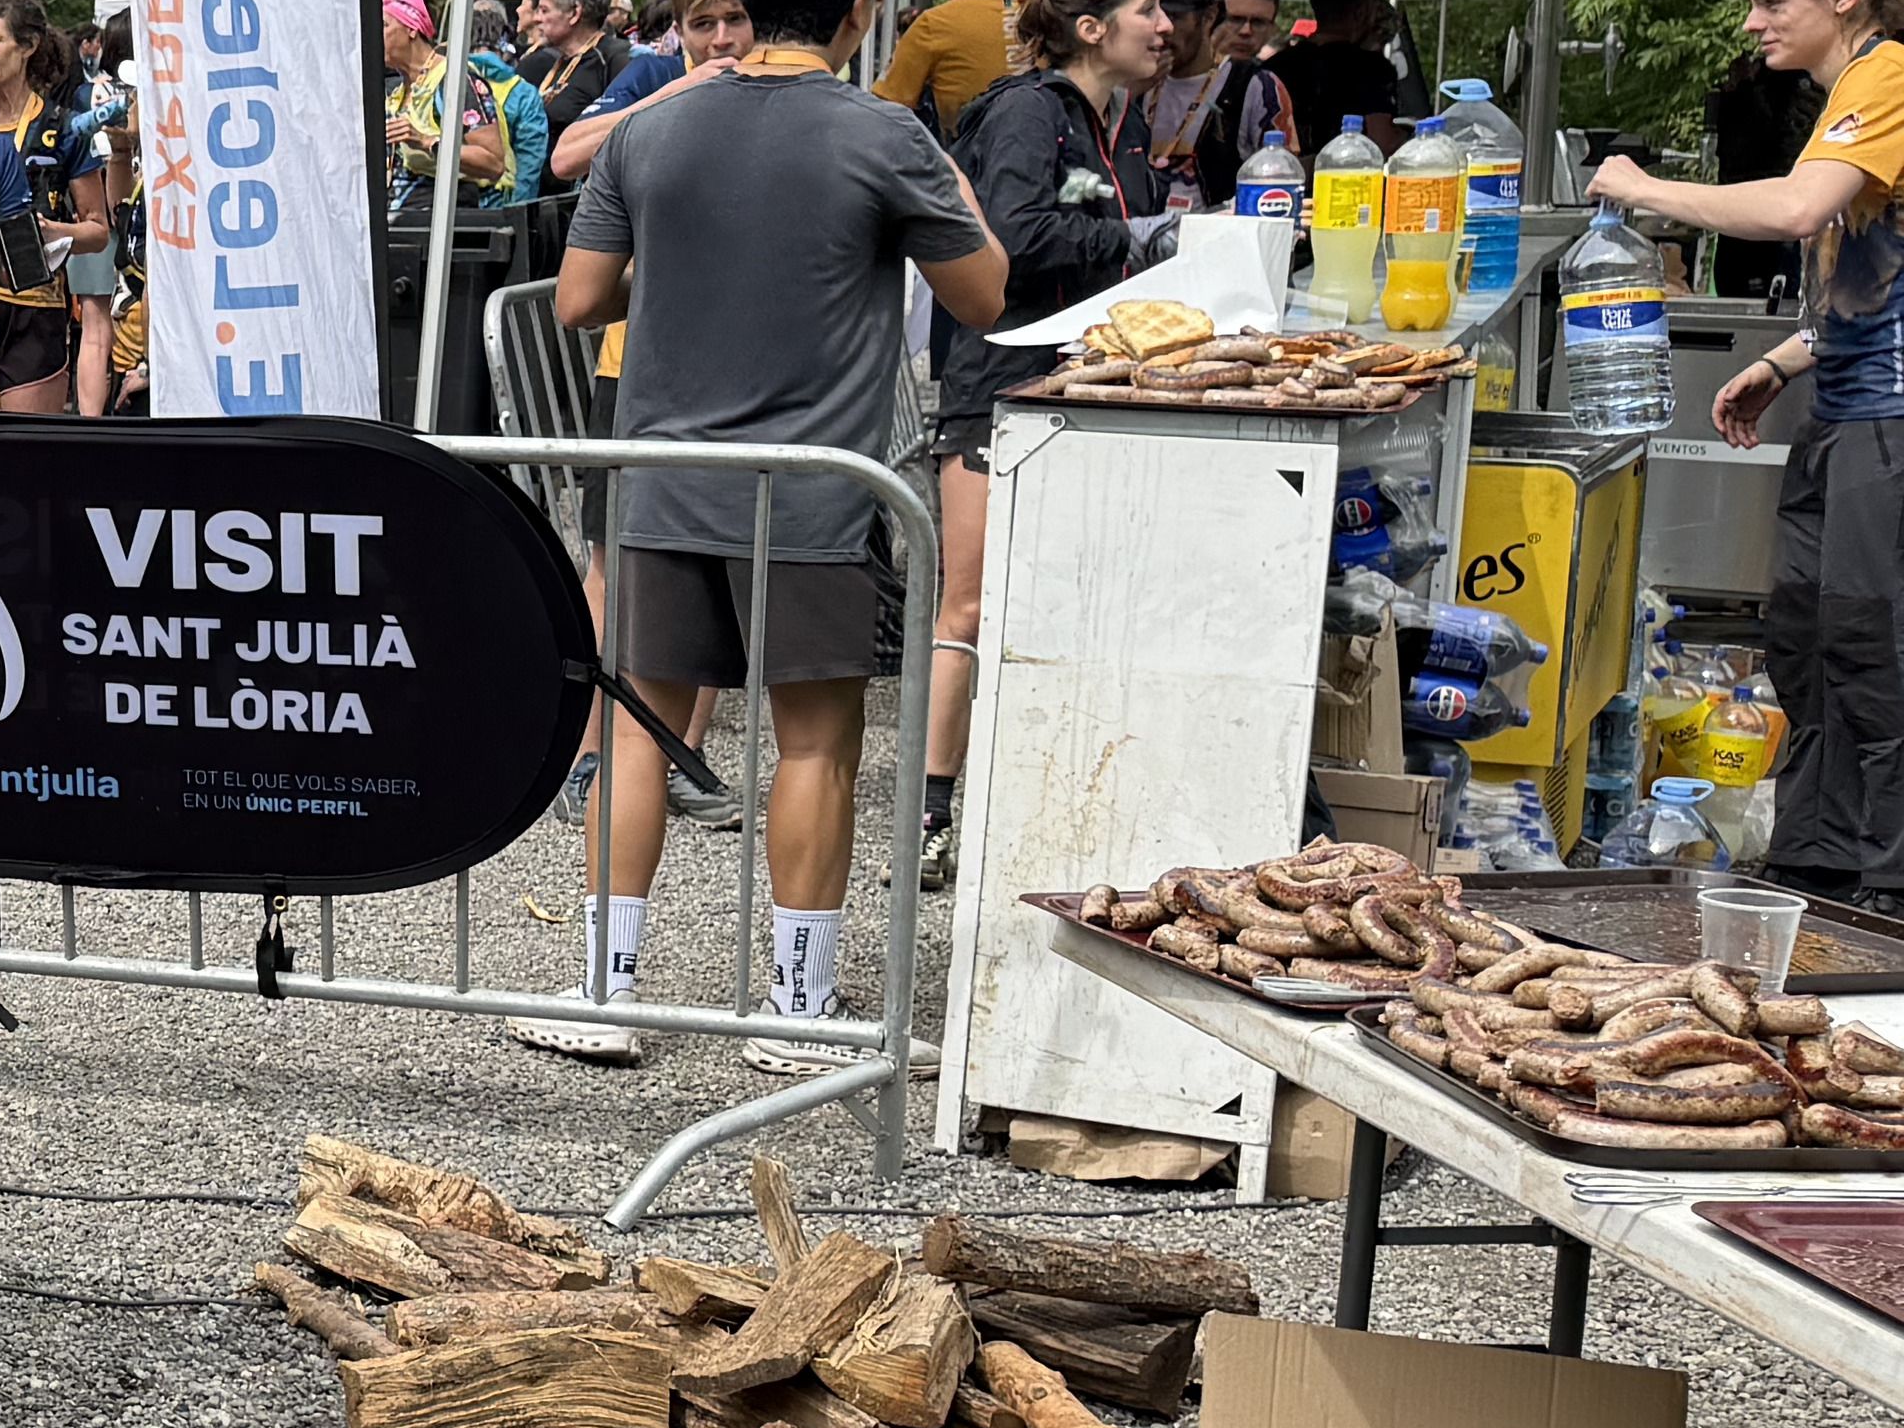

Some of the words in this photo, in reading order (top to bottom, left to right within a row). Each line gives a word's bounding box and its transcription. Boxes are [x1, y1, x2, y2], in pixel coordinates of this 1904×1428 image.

[84, 507, 383, 596] VISIT
[62, 612, 220, 661] SANT
[235, 613, 416, 669] JULIÀ
[104, 683, 179, 726] DE
[193, 677, 374, 735] LÒRIA
[1713, 749, 1744, 762] KAS
[182, 768, 216, 788] TOT
[222, 770, 246, 789] EL
[251, 771, 289, 793] QUE
[293, 773, 345, 795] VOLS
[349, 775, 422, 800] SABER,
[182, 791, 208, 809] EN
[213, 793, 241, 811] UN
[245, 793, 293, 814] ÚNIC
[297, 796, 369, 818] PERFIL
